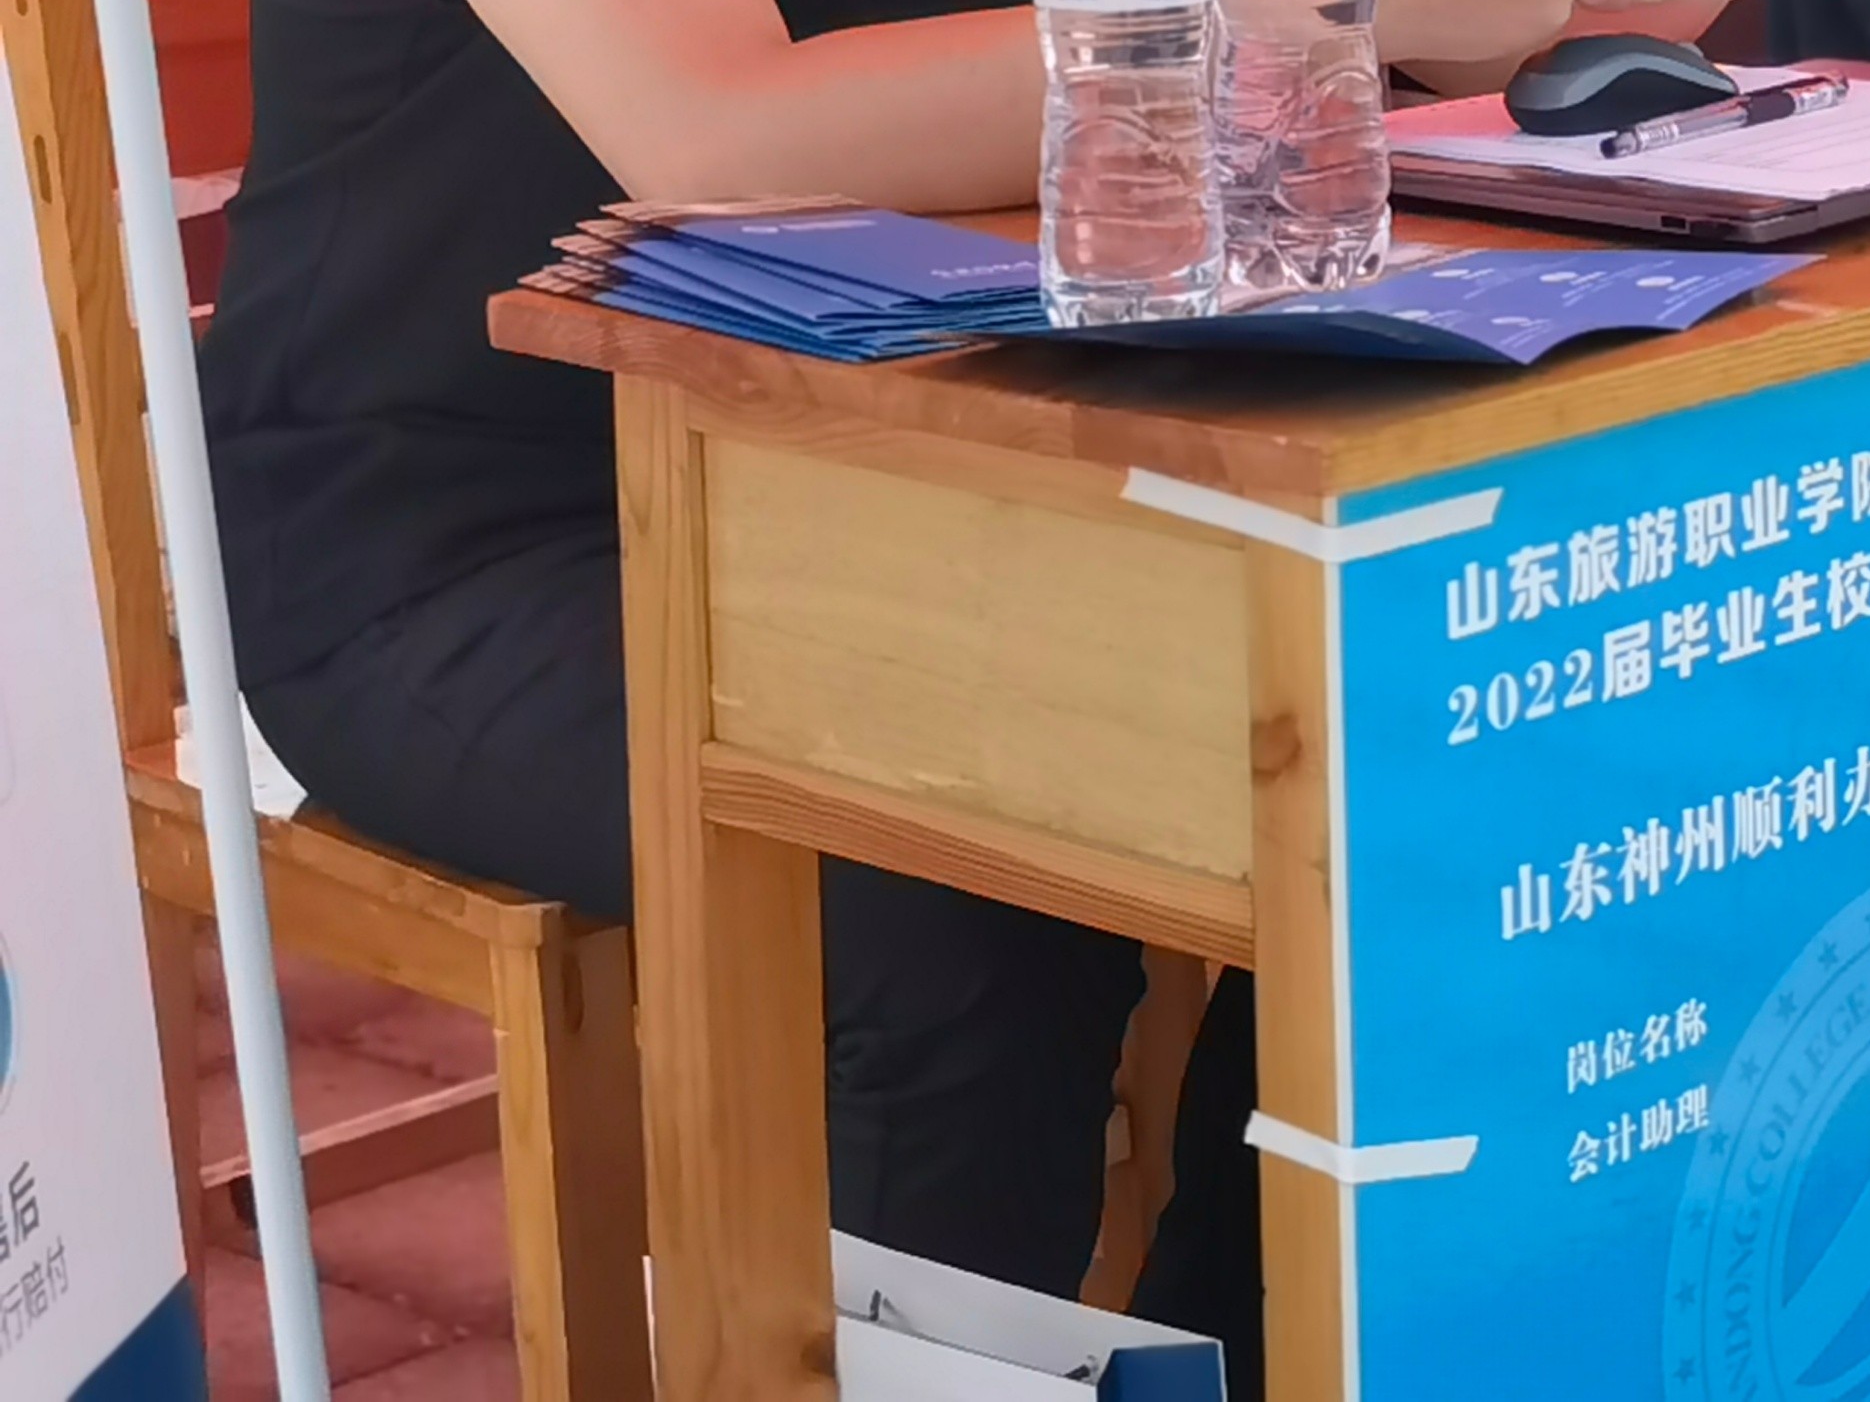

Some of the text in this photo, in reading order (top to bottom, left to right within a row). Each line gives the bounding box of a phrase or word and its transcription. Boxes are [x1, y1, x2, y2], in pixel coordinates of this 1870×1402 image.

[1566, 997, 1709, 1095] 岗位名称
[1566, 1083, 1712, 1183] 会计助理
